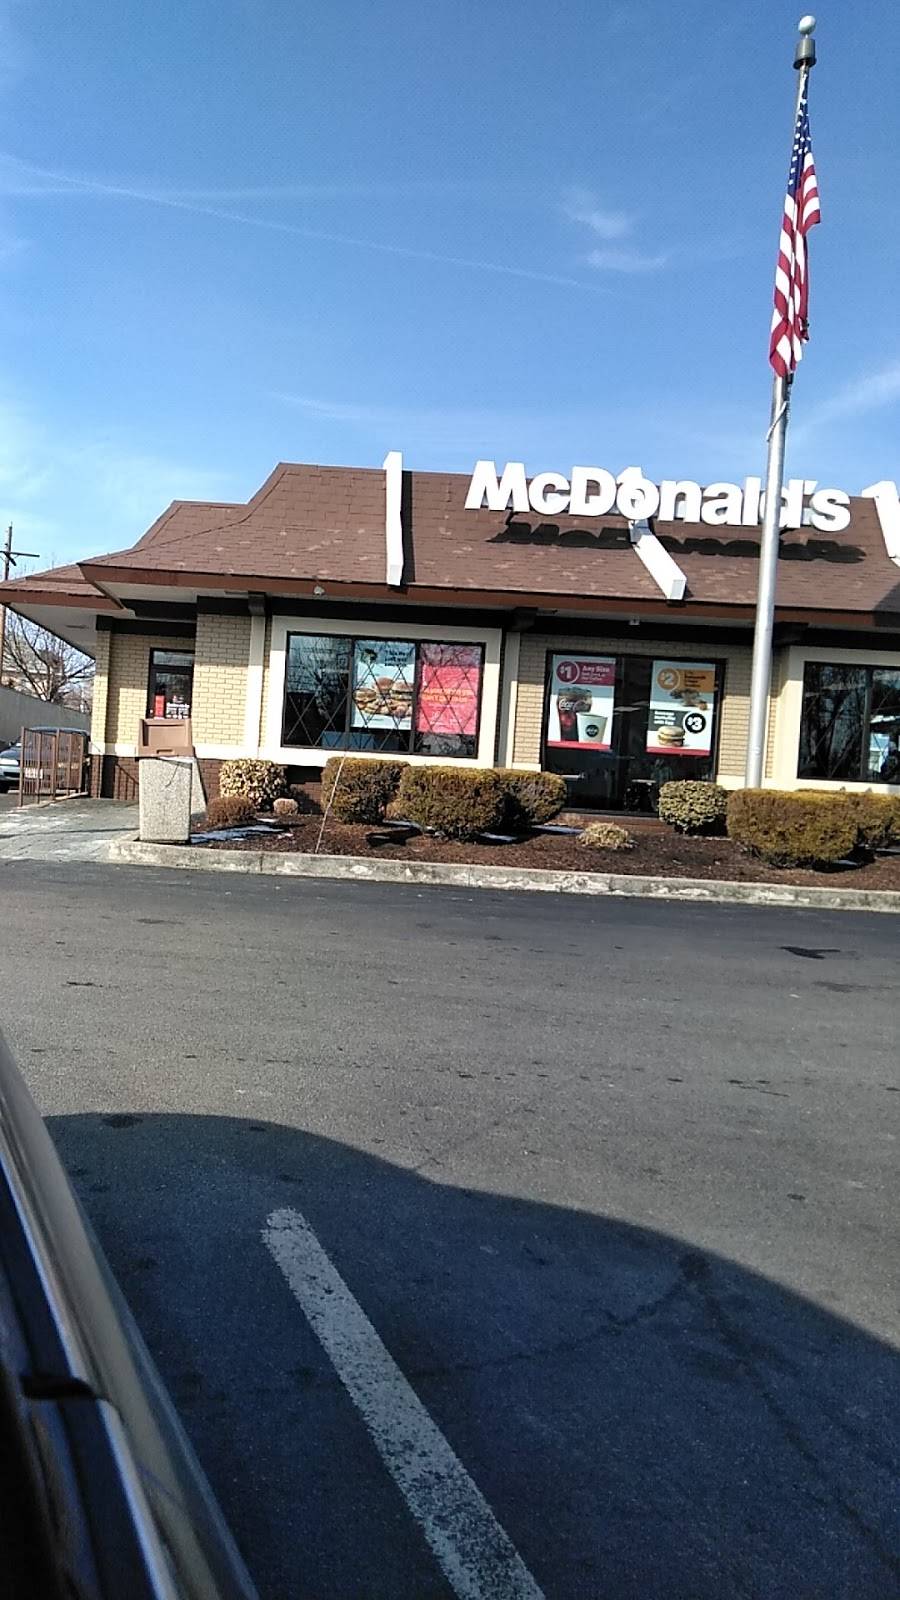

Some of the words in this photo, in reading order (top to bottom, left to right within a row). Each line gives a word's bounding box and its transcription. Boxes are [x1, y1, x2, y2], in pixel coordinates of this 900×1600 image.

[464, 460, 851, 532] McDonald's
[560, 665, 572, 679] $1
[687, 716, 703, 731] $3
